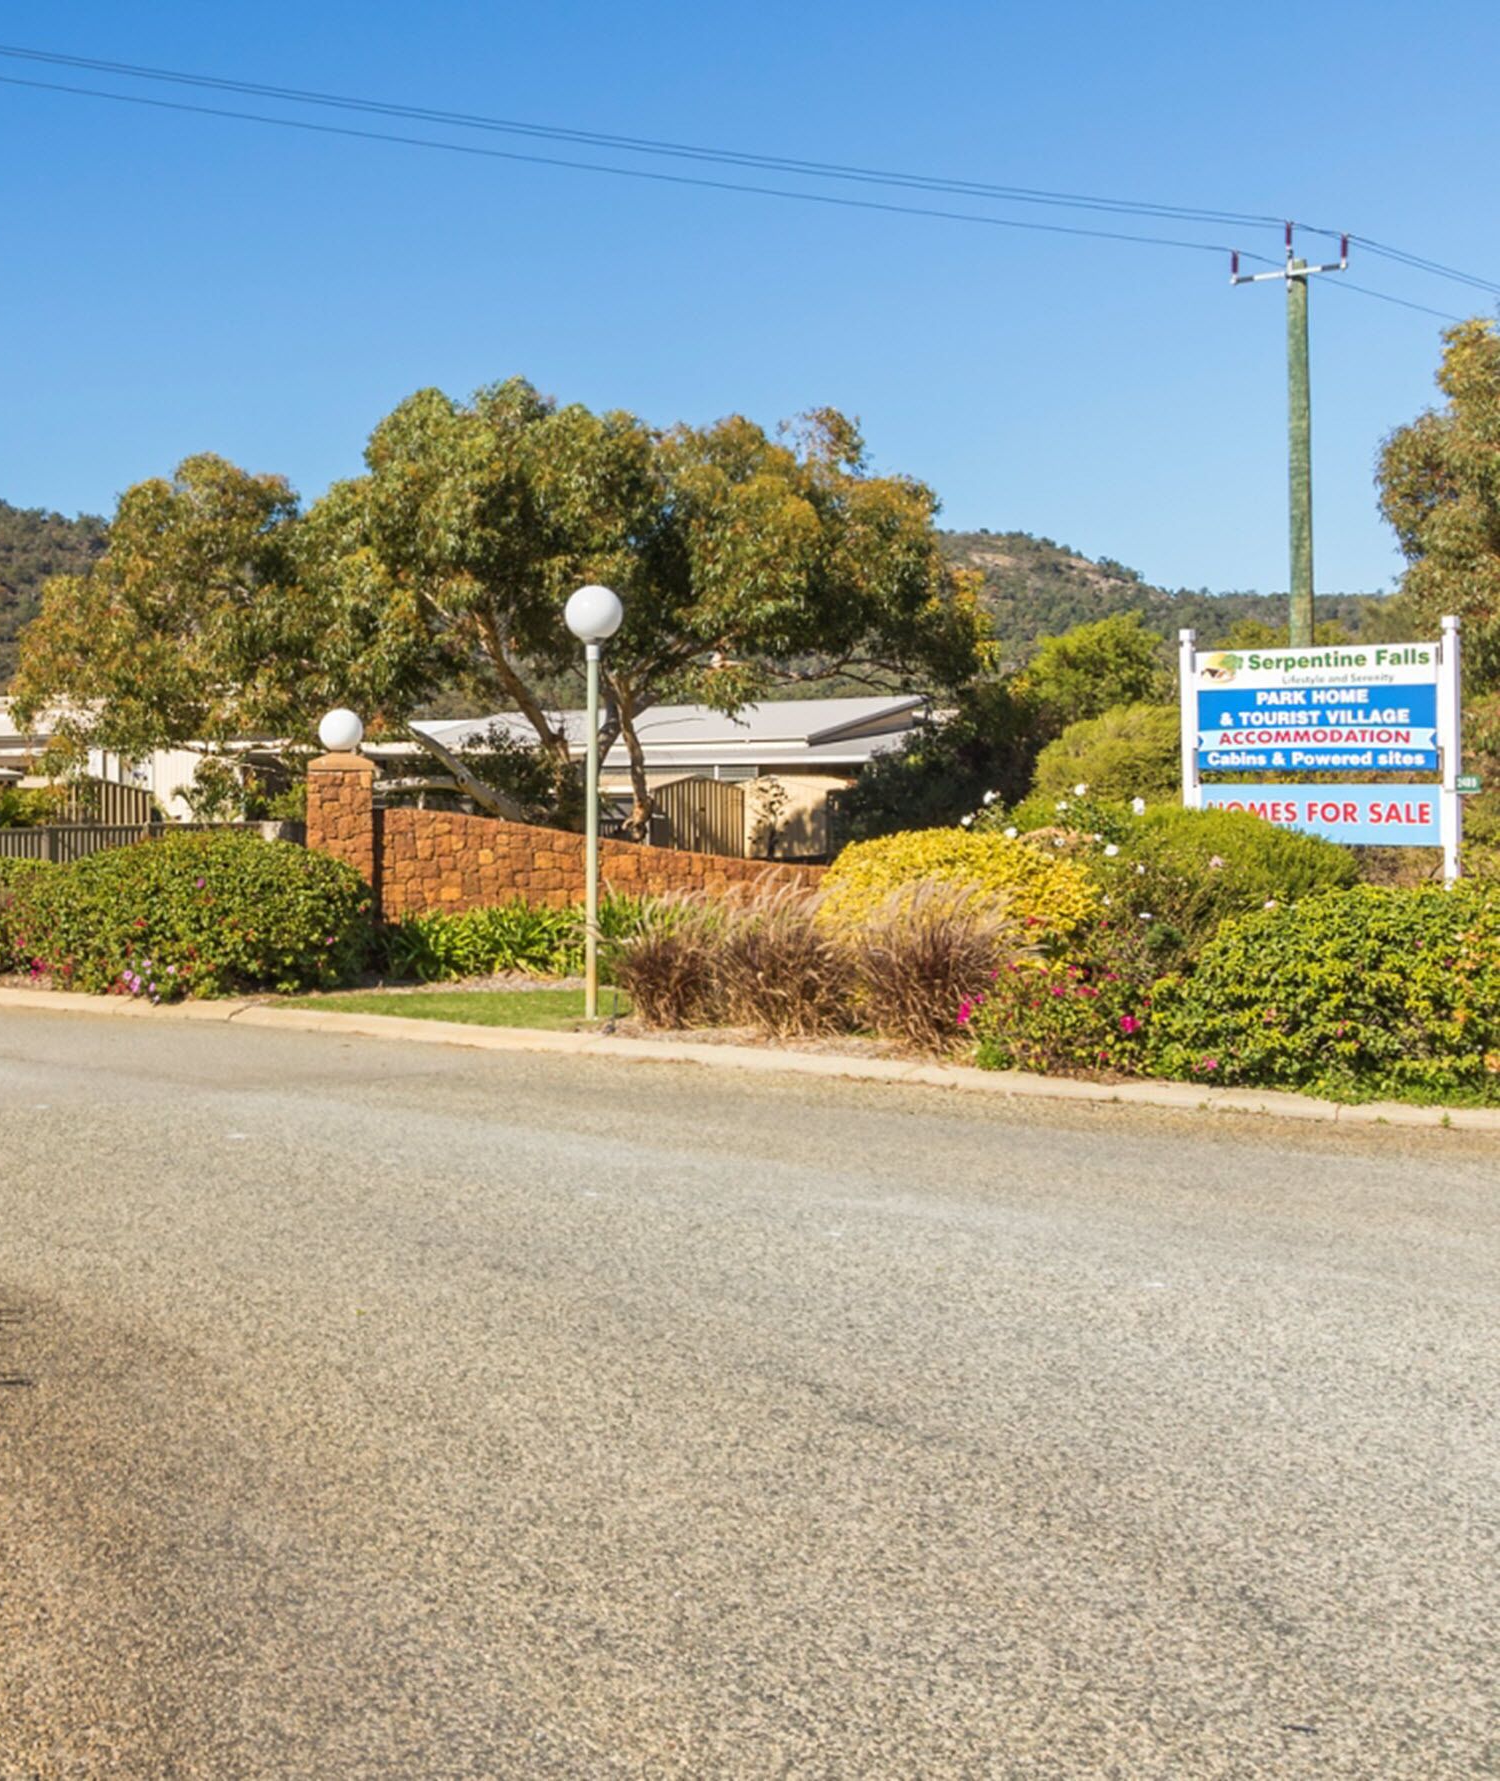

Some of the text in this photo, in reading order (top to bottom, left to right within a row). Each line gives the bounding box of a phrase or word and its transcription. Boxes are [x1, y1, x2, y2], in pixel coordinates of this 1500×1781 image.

[1248, 648, 1430, 672] Serpentine Falls
[1282, 673, 1394, 685] Lifestyle and Serenity
[1256, 688, 1369, 705] PARK HOME
[1219, 708, 1411, 727] & TOURIST VILLAGE
[1219, 729, 1411, 746] ACCOMMODATION
[1207, 751, 1426, 766] Cabins & Powered sites
[1306, 802, 1358, 823] FOR
[1369, 802, 1431, 824] SALE
